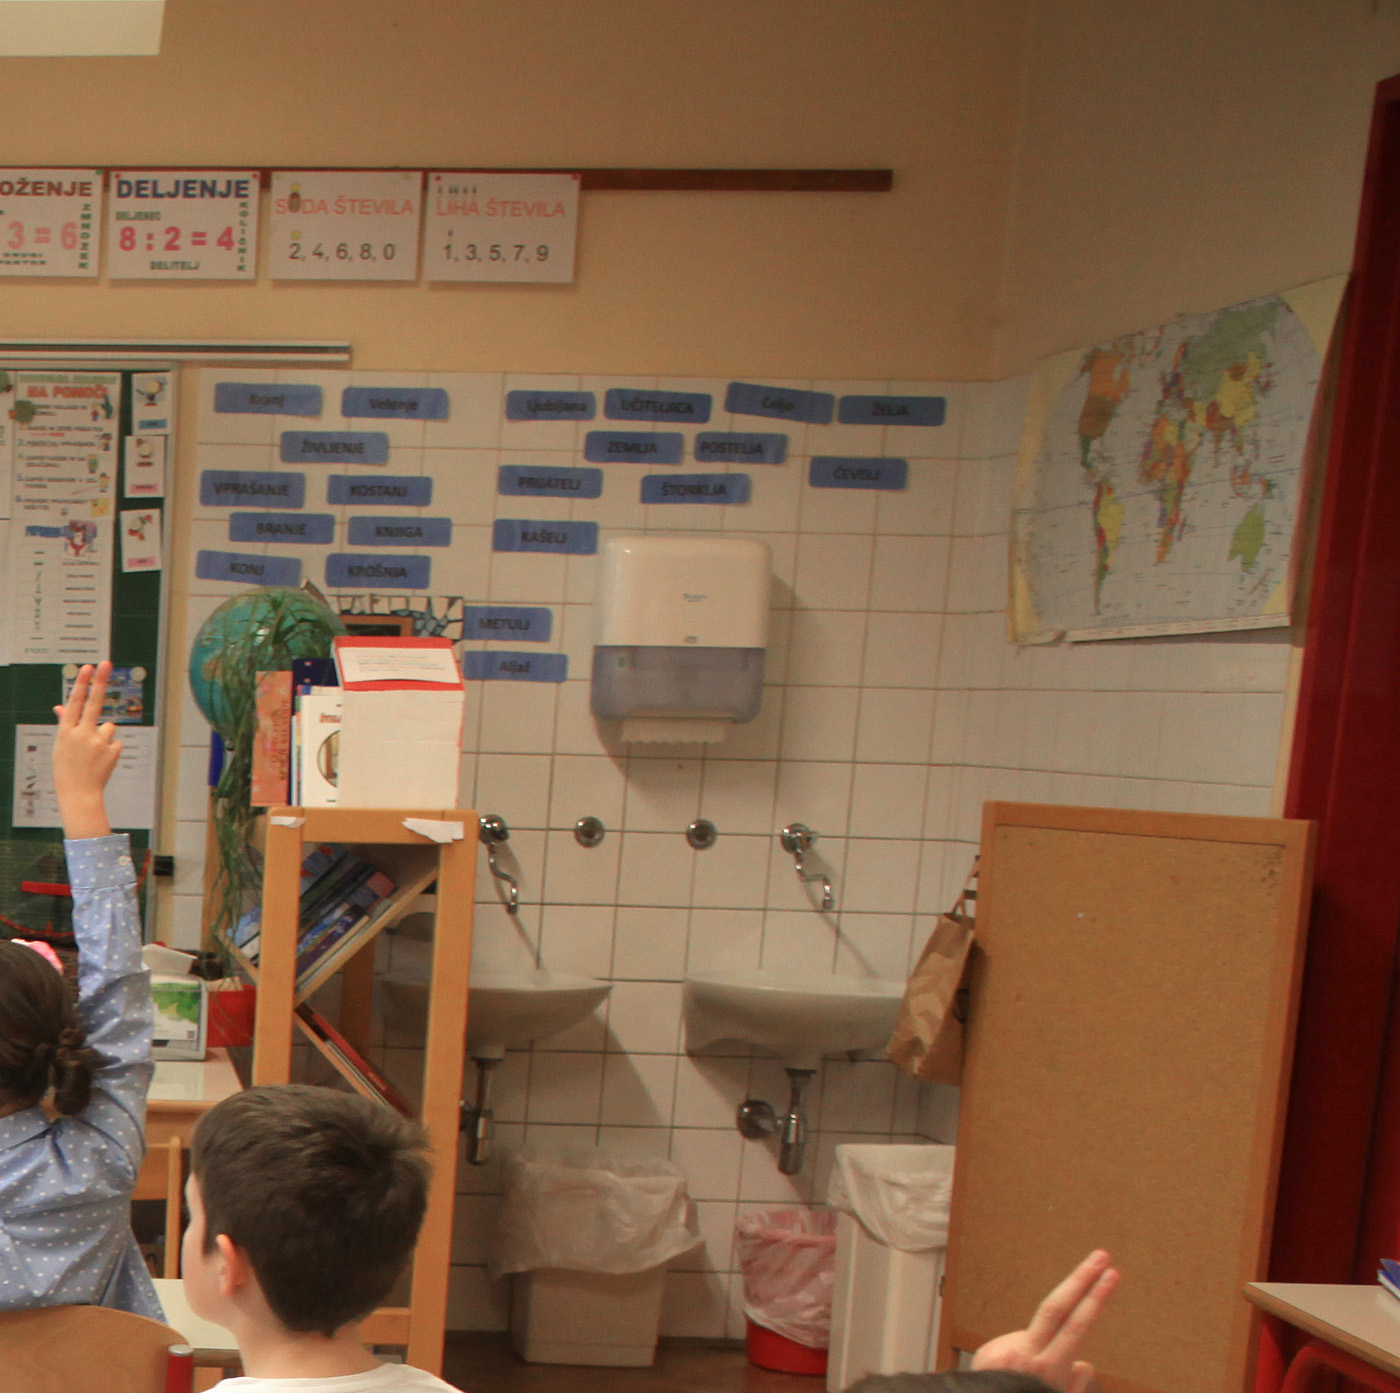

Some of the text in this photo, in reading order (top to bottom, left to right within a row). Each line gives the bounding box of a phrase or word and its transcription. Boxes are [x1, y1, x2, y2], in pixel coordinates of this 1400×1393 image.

[117, 180, 249, 198] DELJENJE
[274, 195, 415, 215] SDA ŠTEVILA
[436, 197, 566, 217] LIHA ŠTEVILA
[8, 221, 24, 250] 3
[62, 222, 78, 250] 6
[120, 227, 136, 251] 8
[164, 227, 180, 251] 2
[216, 226, 234, 251] 4
